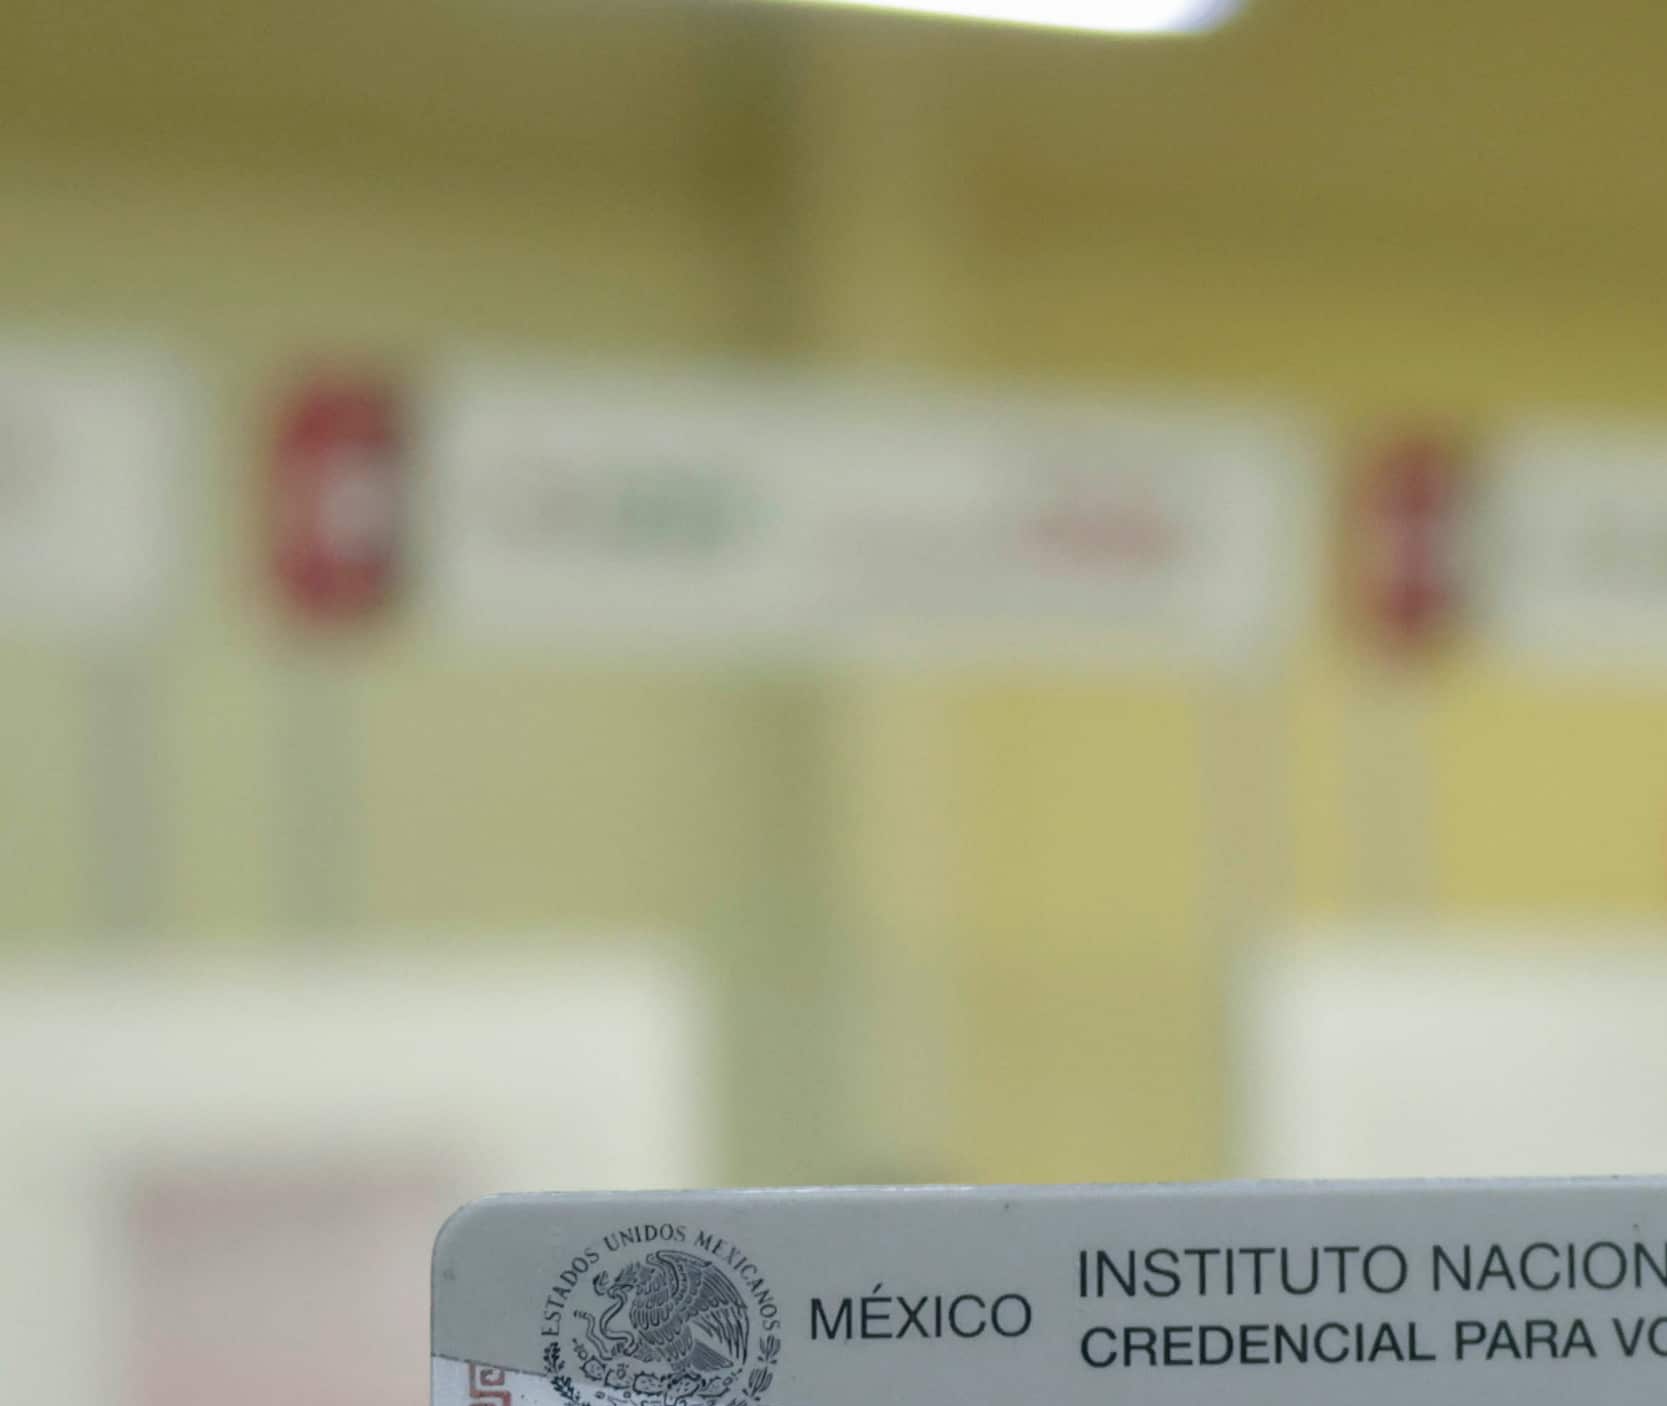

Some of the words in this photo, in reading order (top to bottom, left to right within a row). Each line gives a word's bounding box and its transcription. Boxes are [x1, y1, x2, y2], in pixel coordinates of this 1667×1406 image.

[541, 1246, 601, 1337] ESTADOS
[603, 1223, 687, 1252] UNIDOS
[695, 1229, 781, 1332] MEXICANOS
[1079, 1244, 1408, 1298] INSTITUTO
[810, 1283, 1033, 1341] MÉXICO
[1080, 1321, 1437, 1368] CREDENCIAL
[1455, 1318, 1598, 1361] PARA
